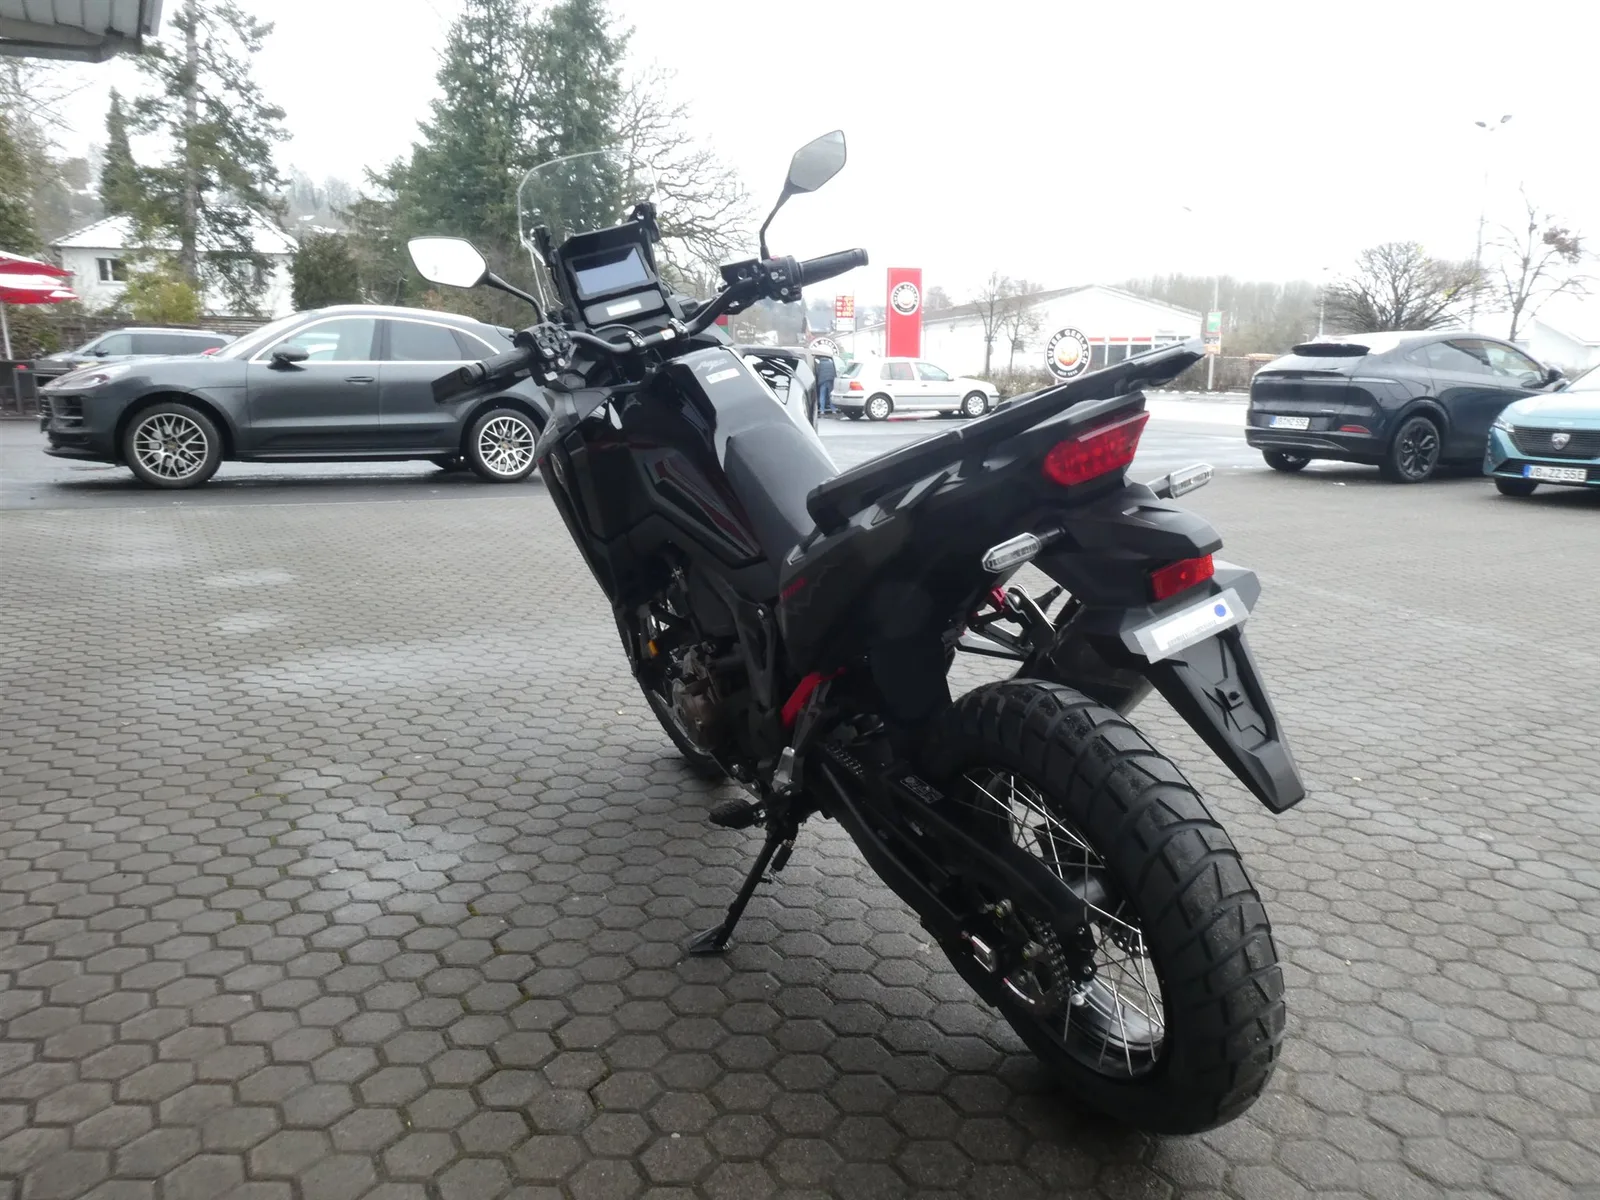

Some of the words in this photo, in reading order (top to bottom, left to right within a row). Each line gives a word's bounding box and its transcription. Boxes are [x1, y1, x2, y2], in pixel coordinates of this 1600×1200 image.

[1047, 333, 1062, 365] GUTER
[1064, 329, 1088, 364] GERLACH
[1548, 468, 1562, 479] ZZ
